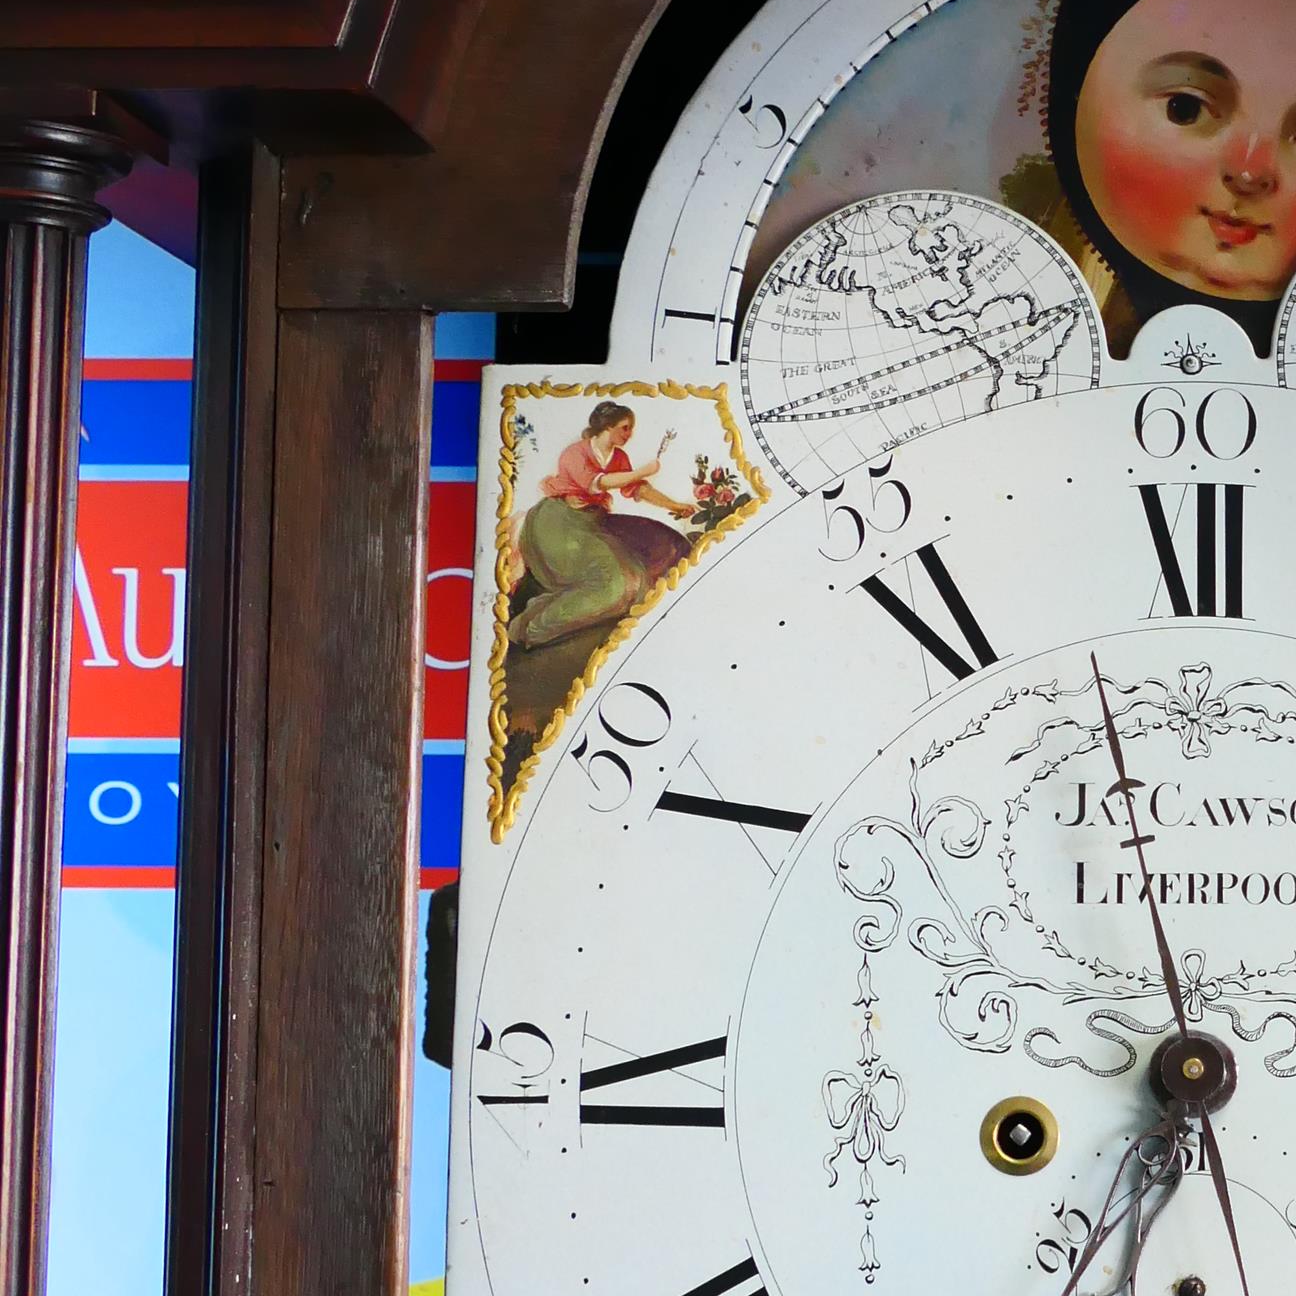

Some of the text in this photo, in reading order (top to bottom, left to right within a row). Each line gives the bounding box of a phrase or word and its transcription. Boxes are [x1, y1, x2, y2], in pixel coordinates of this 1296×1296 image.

[737, 94, 788, 150] 5
[769, 321, 824, 338] OCEAN
[775, 304, 842, 323] EASTERN
[780, 357, 857, 379] THE GREAT
[870, 383, 900, 400] SEA
[880, 423, 928, 452] PACIFIC
[1133, 387, 1258, 461] 60
[817, 454, 913, 563] 55
[1128, 482, 1257, 621] XII
[845, 533, 1014, 714] XI
[571, 681, 672, 813] 50
[647, 739, 823, 889] X
[475, 1017, 555, 1160] 45
[579, 1010, 731, 1149] IX
[1035, 1196, 1092, 1275] 25
